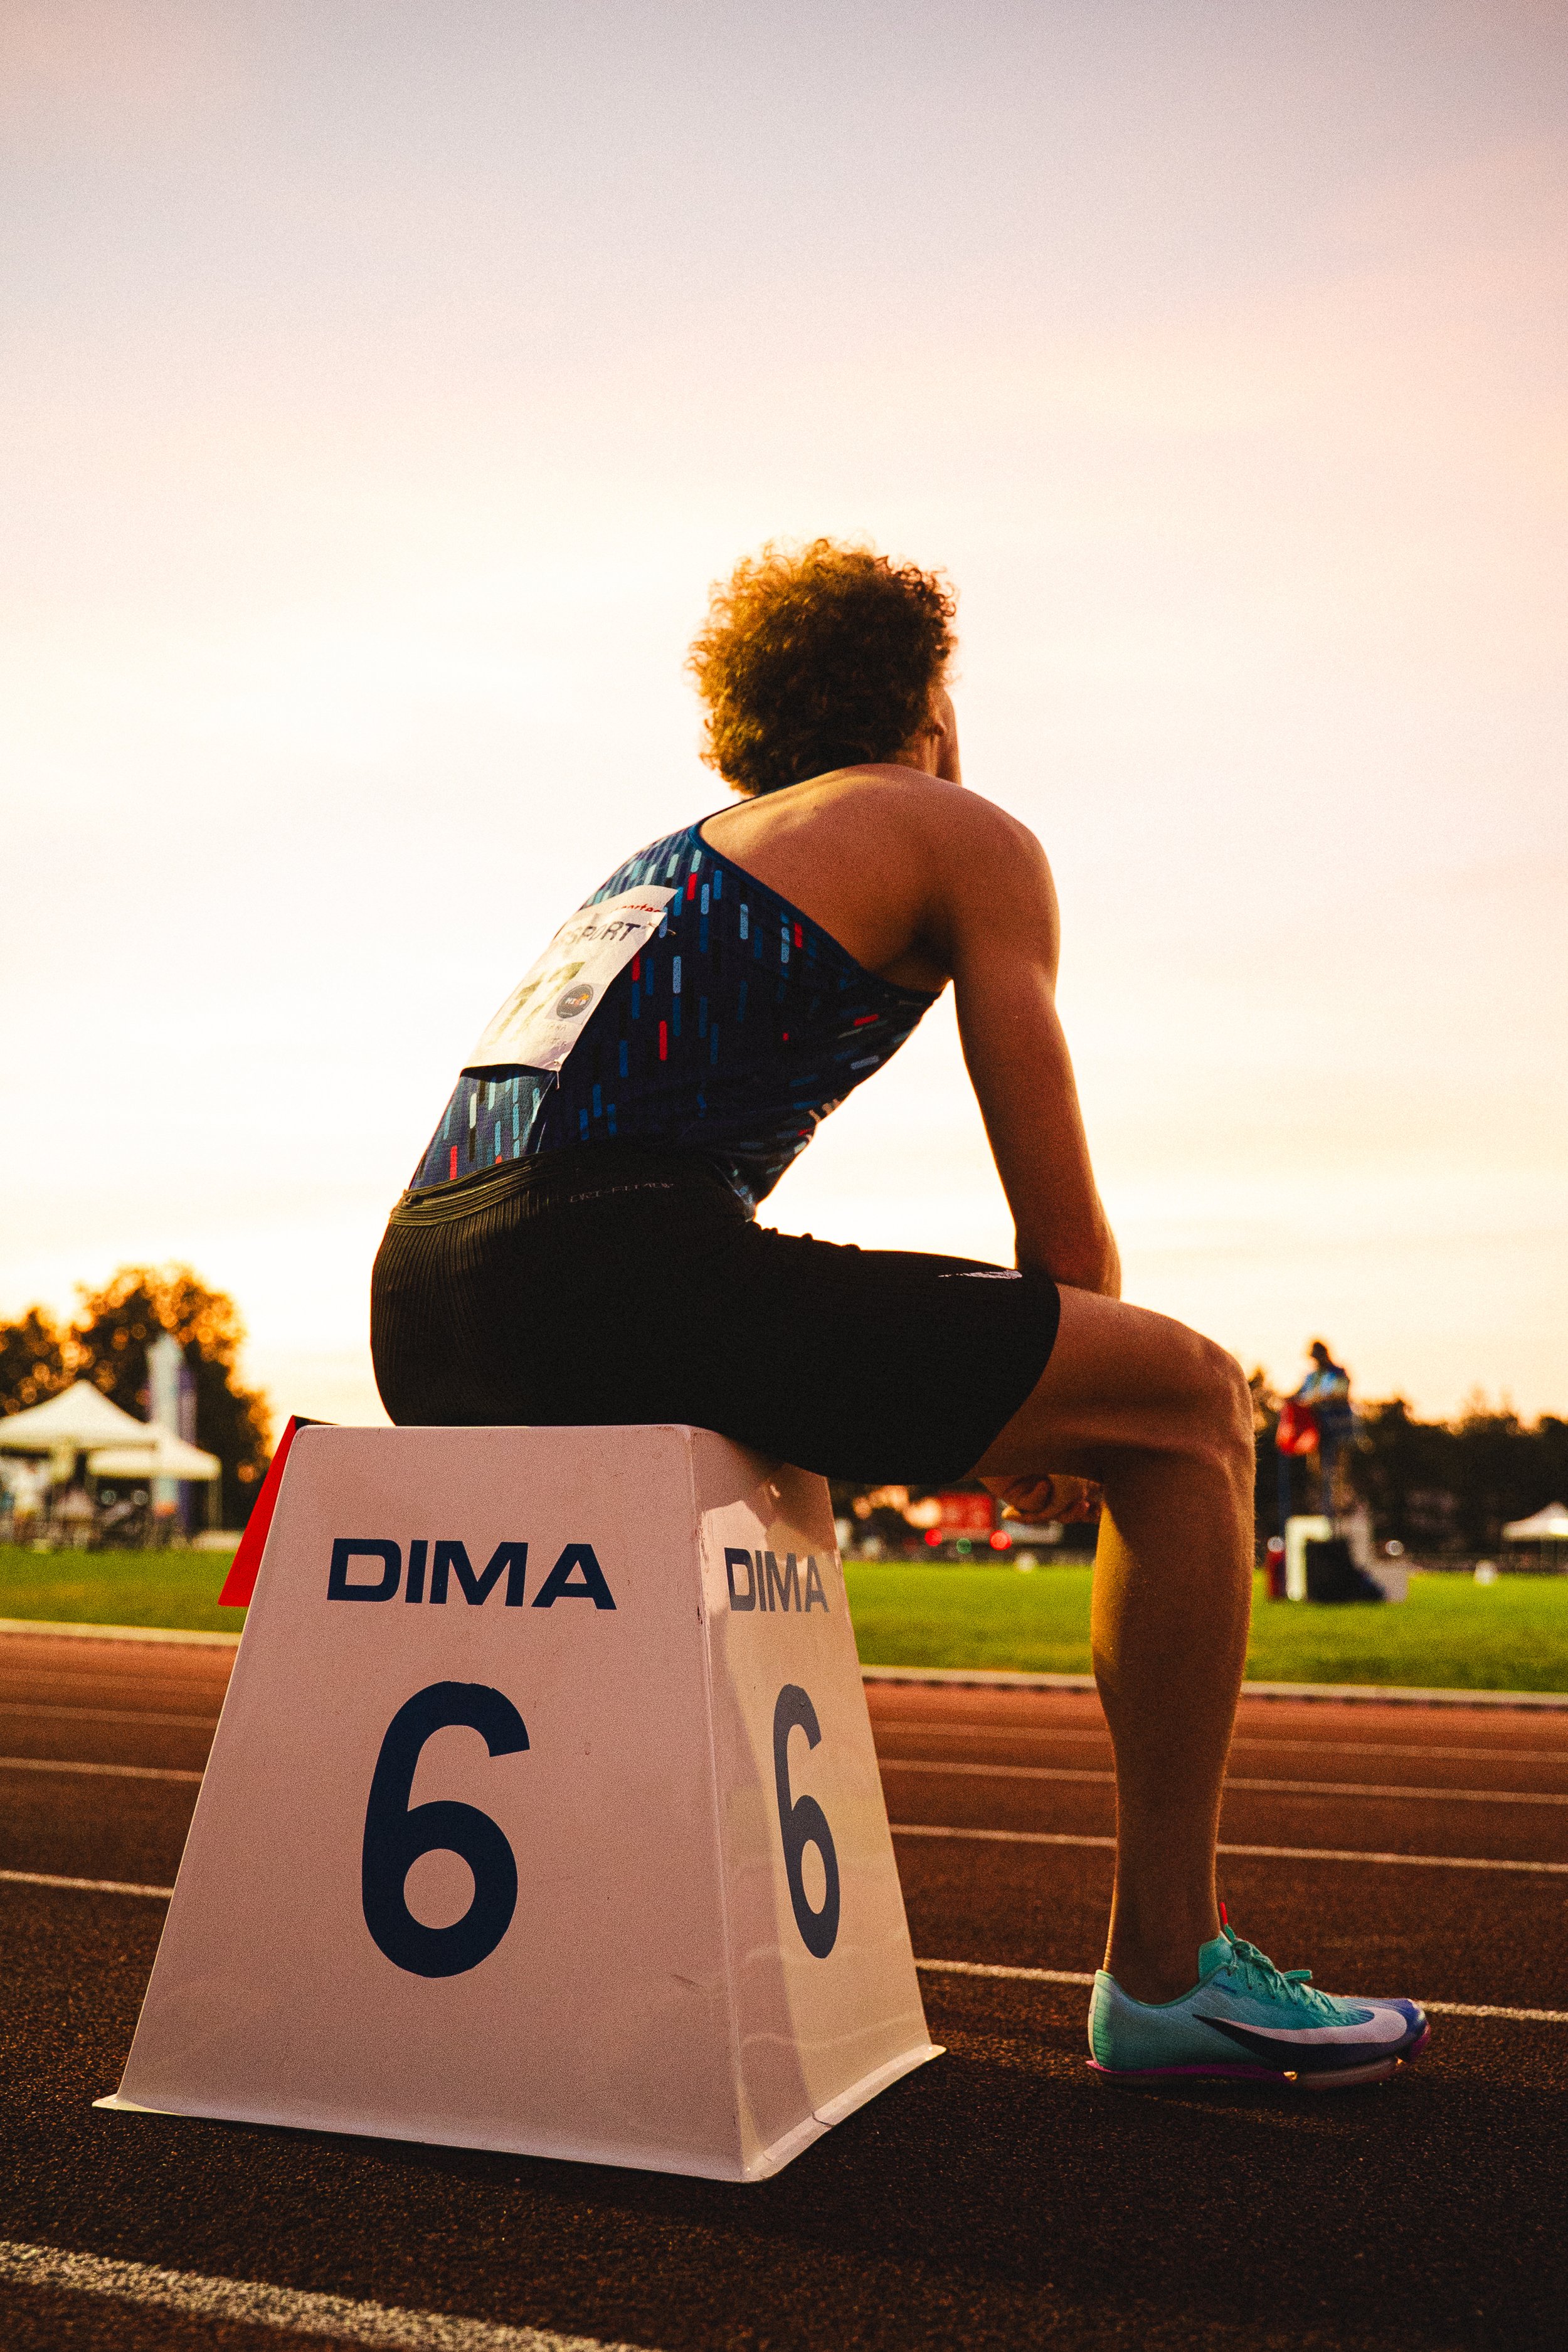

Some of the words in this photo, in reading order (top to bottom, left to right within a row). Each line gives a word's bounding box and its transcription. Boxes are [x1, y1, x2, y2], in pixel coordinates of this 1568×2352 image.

[327, 1539, 616, 1610] DIMA
[724, 1547, 829, 1612] DIMA
[362, 1682, 529, 1978] 6
[774, 1684, 840, 1959] 6
